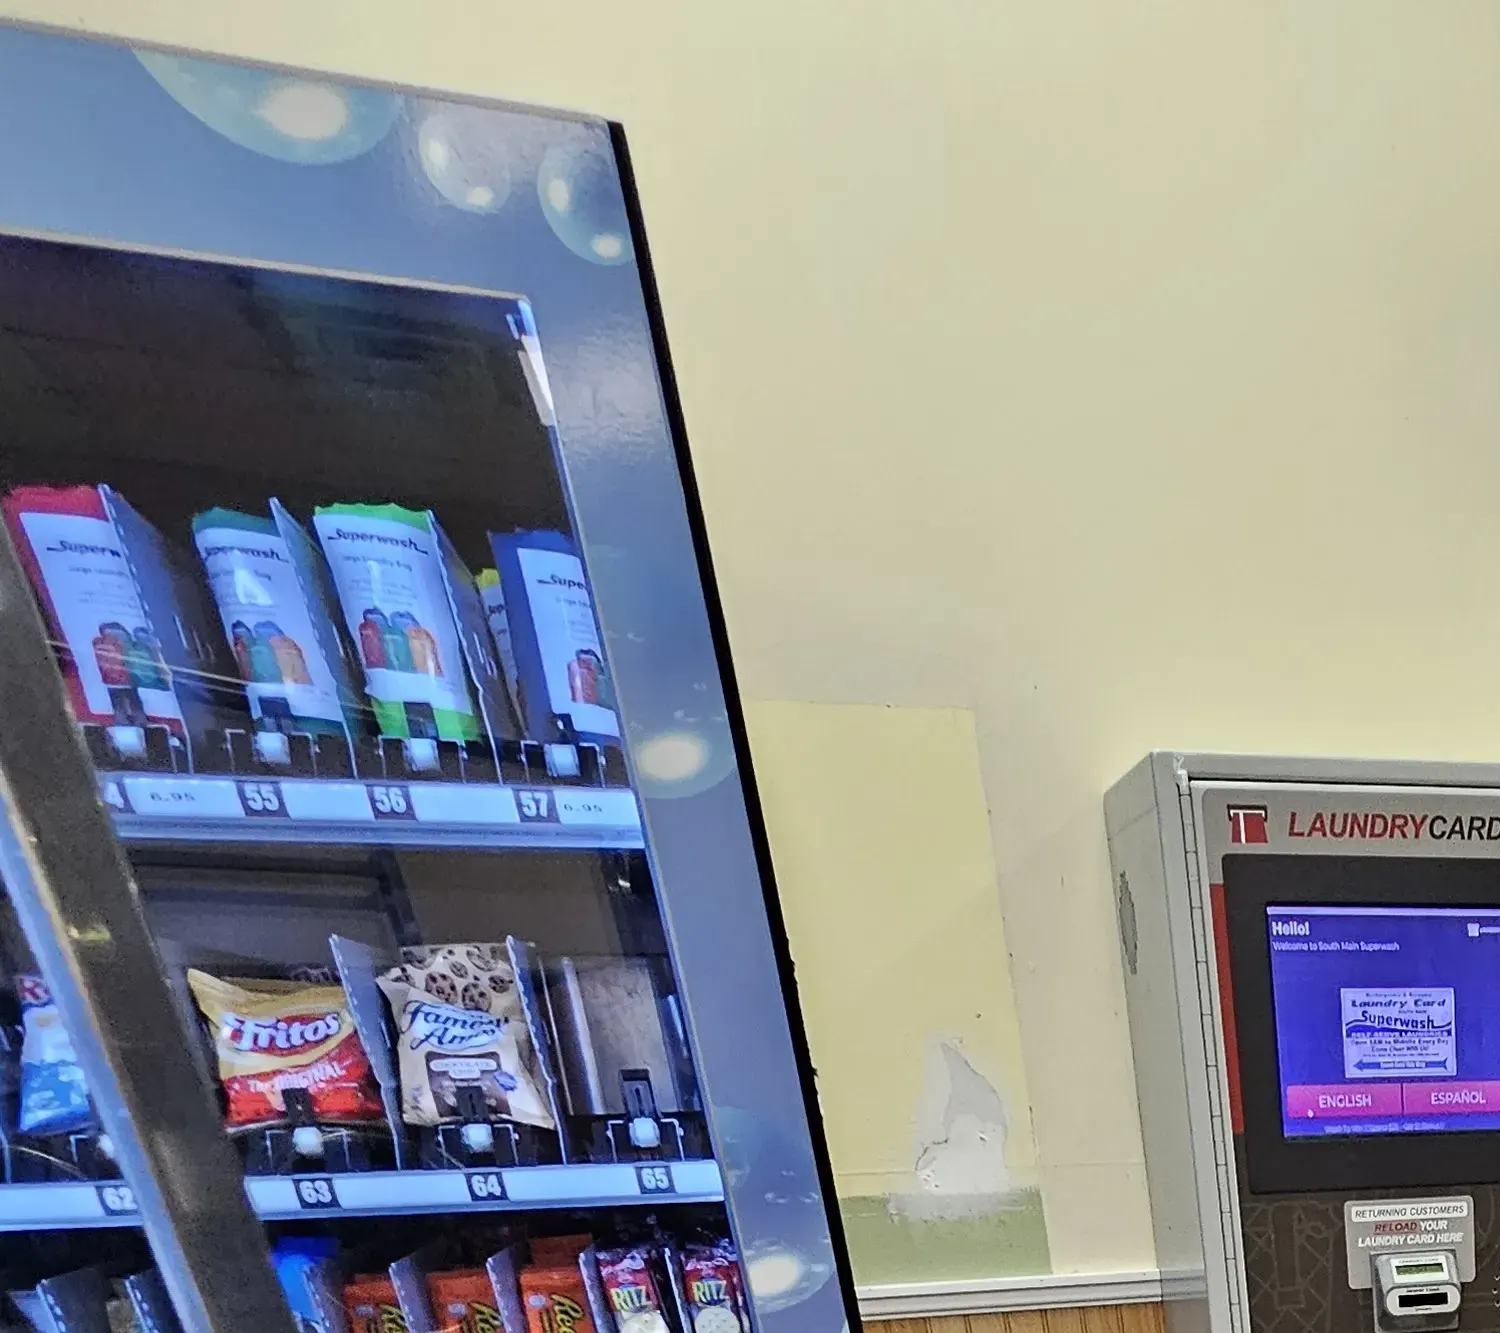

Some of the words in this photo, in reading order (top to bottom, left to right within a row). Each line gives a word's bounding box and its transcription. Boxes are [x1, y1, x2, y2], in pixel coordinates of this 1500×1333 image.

[334, 527, 419, 550] Superwash
[243, 783, 280, 812] 55
[373, 786, 407, 814] 56
[519, 791, 548, 818] 57
[1271, 920, 1310, 936] Hello!
[1272, 940, 1309, 951] Welcome
[1309, 941, 1318, 951] to
[1318, 940, 1340, 951] South
[1360, 940, 1400, 952] Superwash
[1351, 998, 1407, 1009] Laundry
[1413, 998, 1446, 1008] Card
[1361, 1010, 1435, 1029] Superwash
[222, 1011, 340, 1051] Fritos
[1318, 1094, 1372, 1109] ENGLISH
[1430, 1090, 1486, 1106] ESPAÑOL
[103, 1187, 138, 1211] 62
[299, 1180, 333, 1204] 63
[470, 1175, 501, 1198] 64
[640, 1167, 670, 1190] 65
[1355, 1207, 1407, 1219] RETURNING
[1409, 1205, 1464, 1216] CUSTOMERS
[1374, 1221, 1418, 1232] RELOAD
[1419, 1220, 1448, 1231] YOUR
[1357, 1235, 1406, 1248] LAUNDRY
[1406, 1234, 1435, 1244] CARD
[1436, 1232, 1464, 1243] HERE
[610, 1286, 652, 1311] RITZ
[692, 1279, 730, 1303] RITZ
